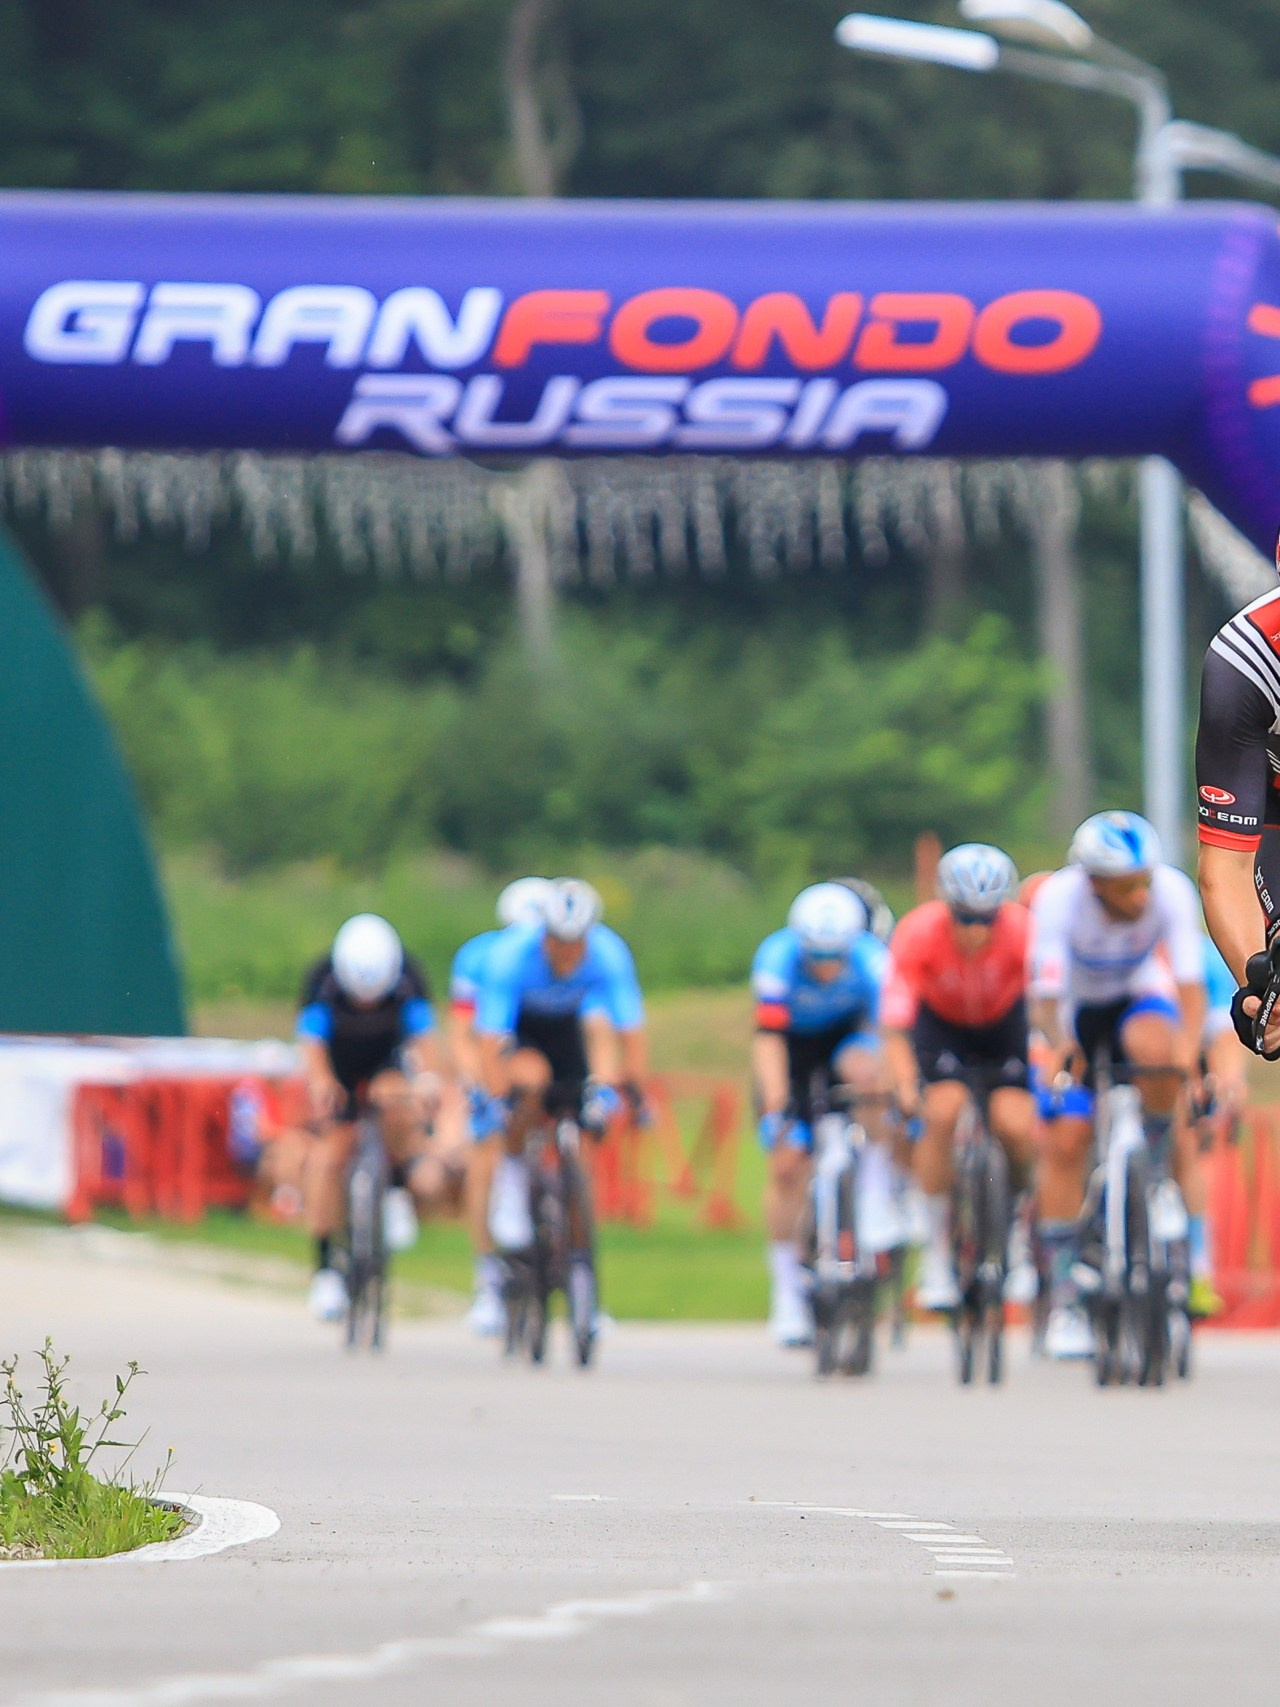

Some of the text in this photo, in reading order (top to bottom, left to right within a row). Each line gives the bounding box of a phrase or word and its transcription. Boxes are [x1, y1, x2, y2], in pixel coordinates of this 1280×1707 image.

[24, 280, 1102, 374] GRANFONDO
[334, 374, 949, 453] RUSSIA
[1259, 991, 1277, 1027] EMPIRE
